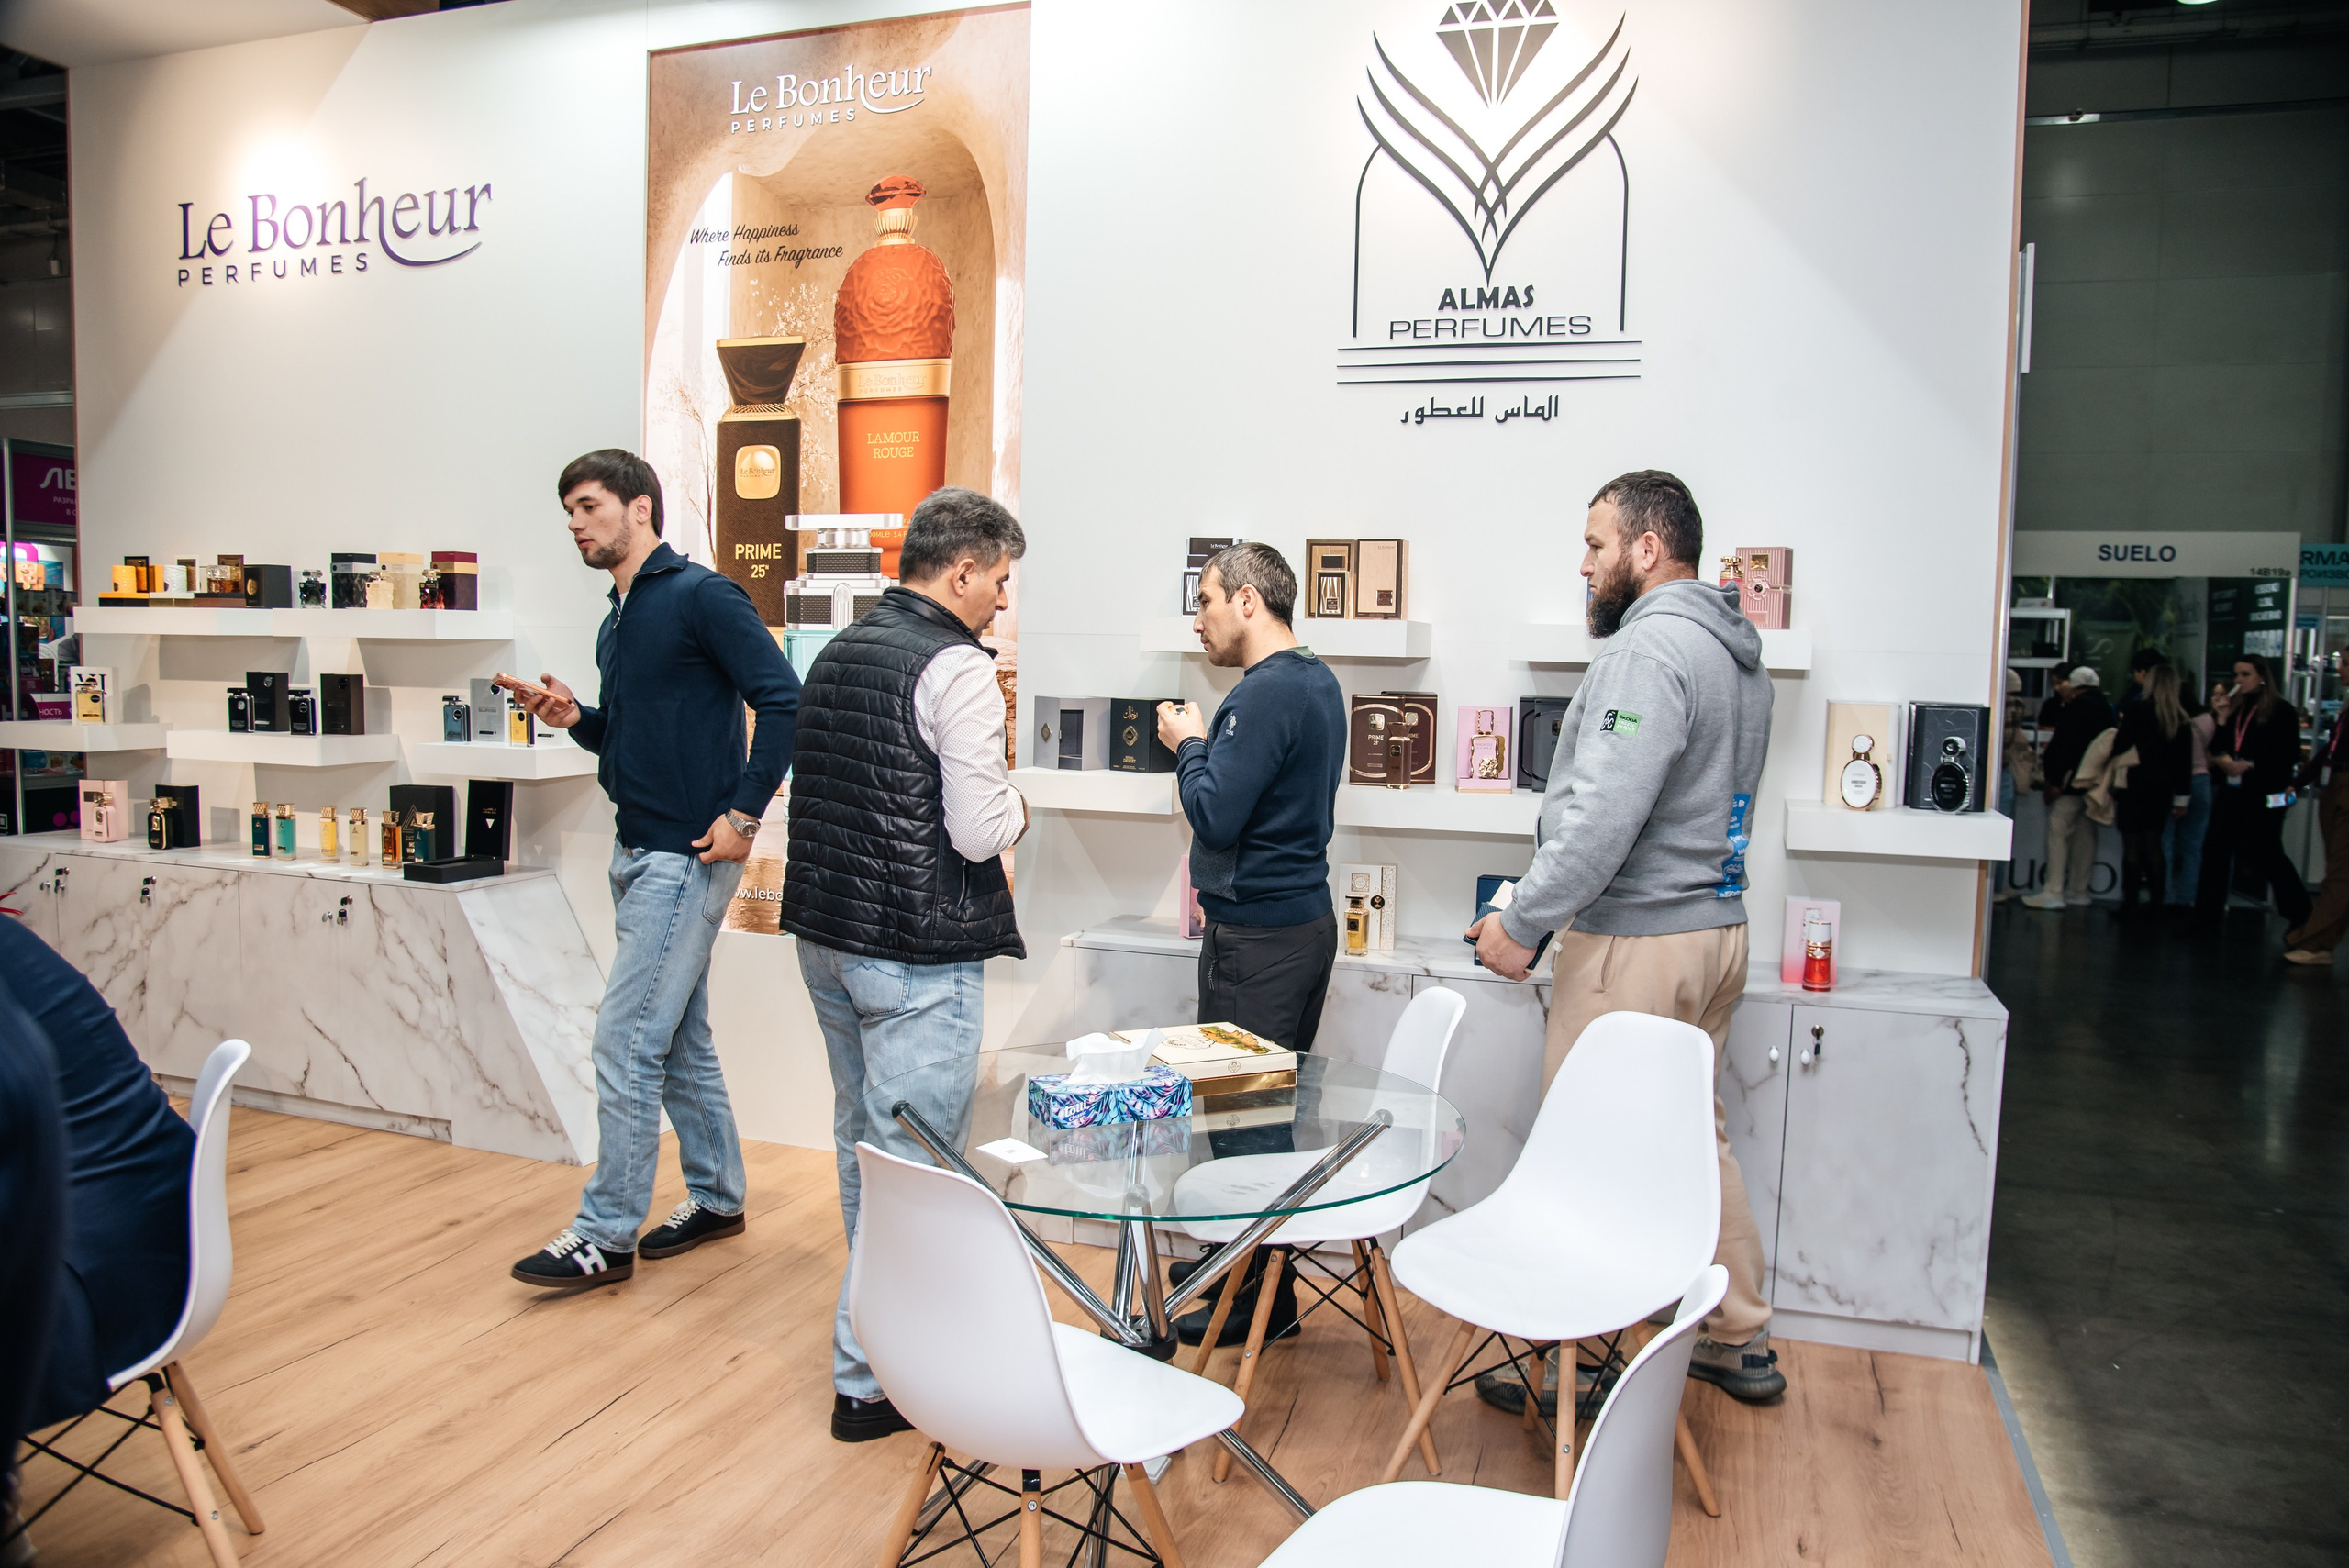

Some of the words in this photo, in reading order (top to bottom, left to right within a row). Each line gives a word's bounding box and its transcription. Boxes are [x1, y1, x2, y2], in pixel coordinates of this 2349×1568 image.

[730, 80, 768, 115] Le
[775, 63, 932, 115] Bonheur
[730, 107, 856, 135] PERFUMES
[178, 202, 234, 261] Le
[247, 176, 493, 268] Bonheur
[690, 227, 730, 244] Where
[733, 224, 799, 244] Happiness
[178, 252, 369, 288] PERFUMES
[718, 249, 752, 266] Finds
[754, 249, 772, 263] its
[774, 245, 843, 269] Fragrance
[1437, 284, 1535, 311] ALMAS
[1389, 315, 1592, 340] PERFUMES
[1400, 395, 1485, 425] للعطور
[1495, 395, 1559, 424] الماس
[867, 431, 920, 445] L'AMOUR
[873, 446, 914, 459] ROUGE
[735, 543, 782, 560] PRIME
[2098, 544, 2177, 562] SUELO
